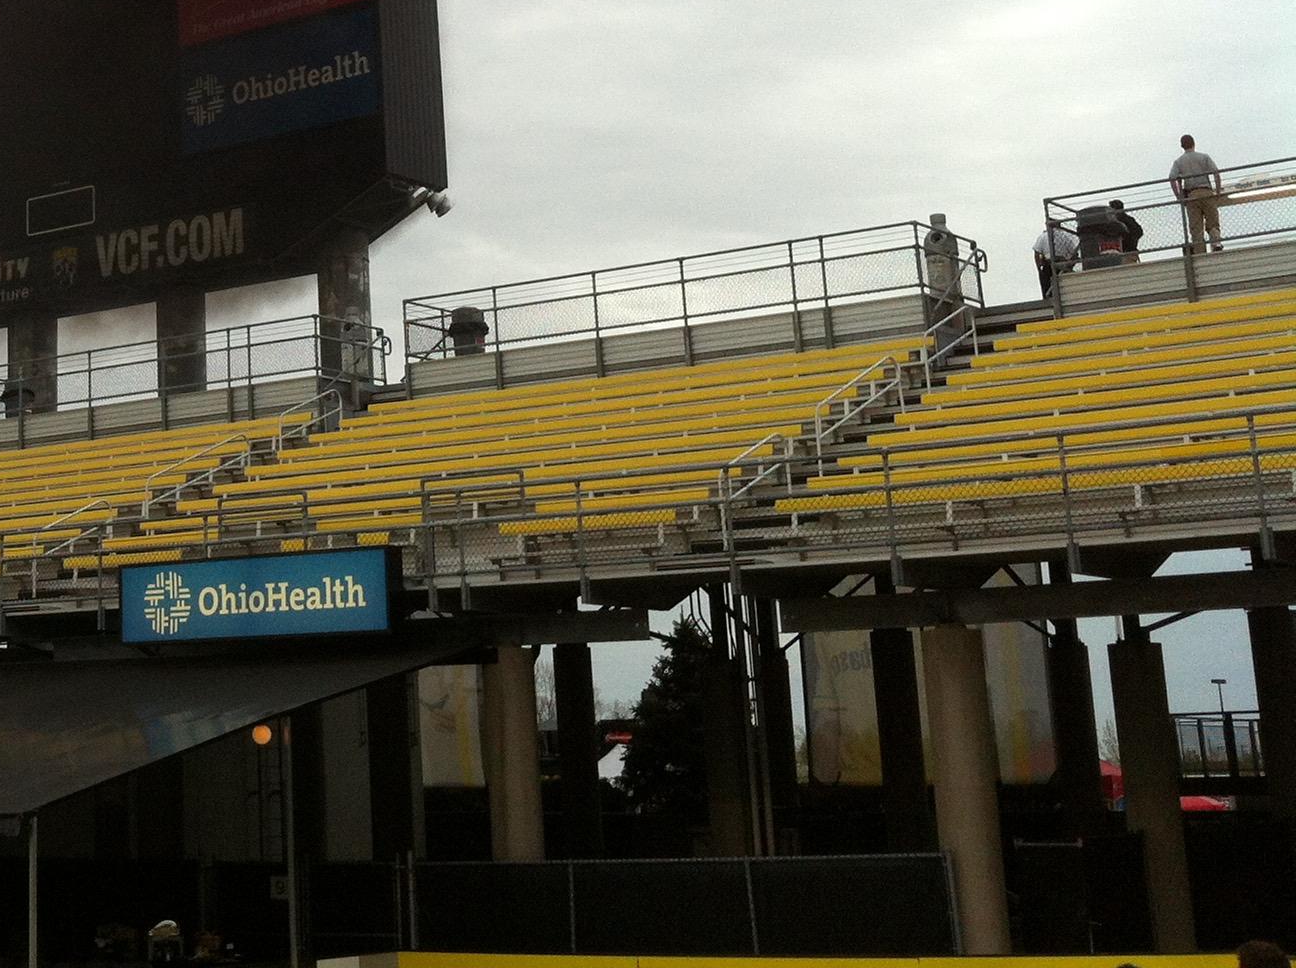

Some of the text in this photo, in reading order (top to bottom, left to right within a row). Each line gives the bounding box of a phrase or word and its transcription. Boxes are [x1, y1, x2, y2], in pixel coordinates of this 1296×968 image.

[232, 51, 371, 105] OhioHealth
[96, 208, 244, 278] VCF.COM
[198, 575, 367, 617] OhioHealth
